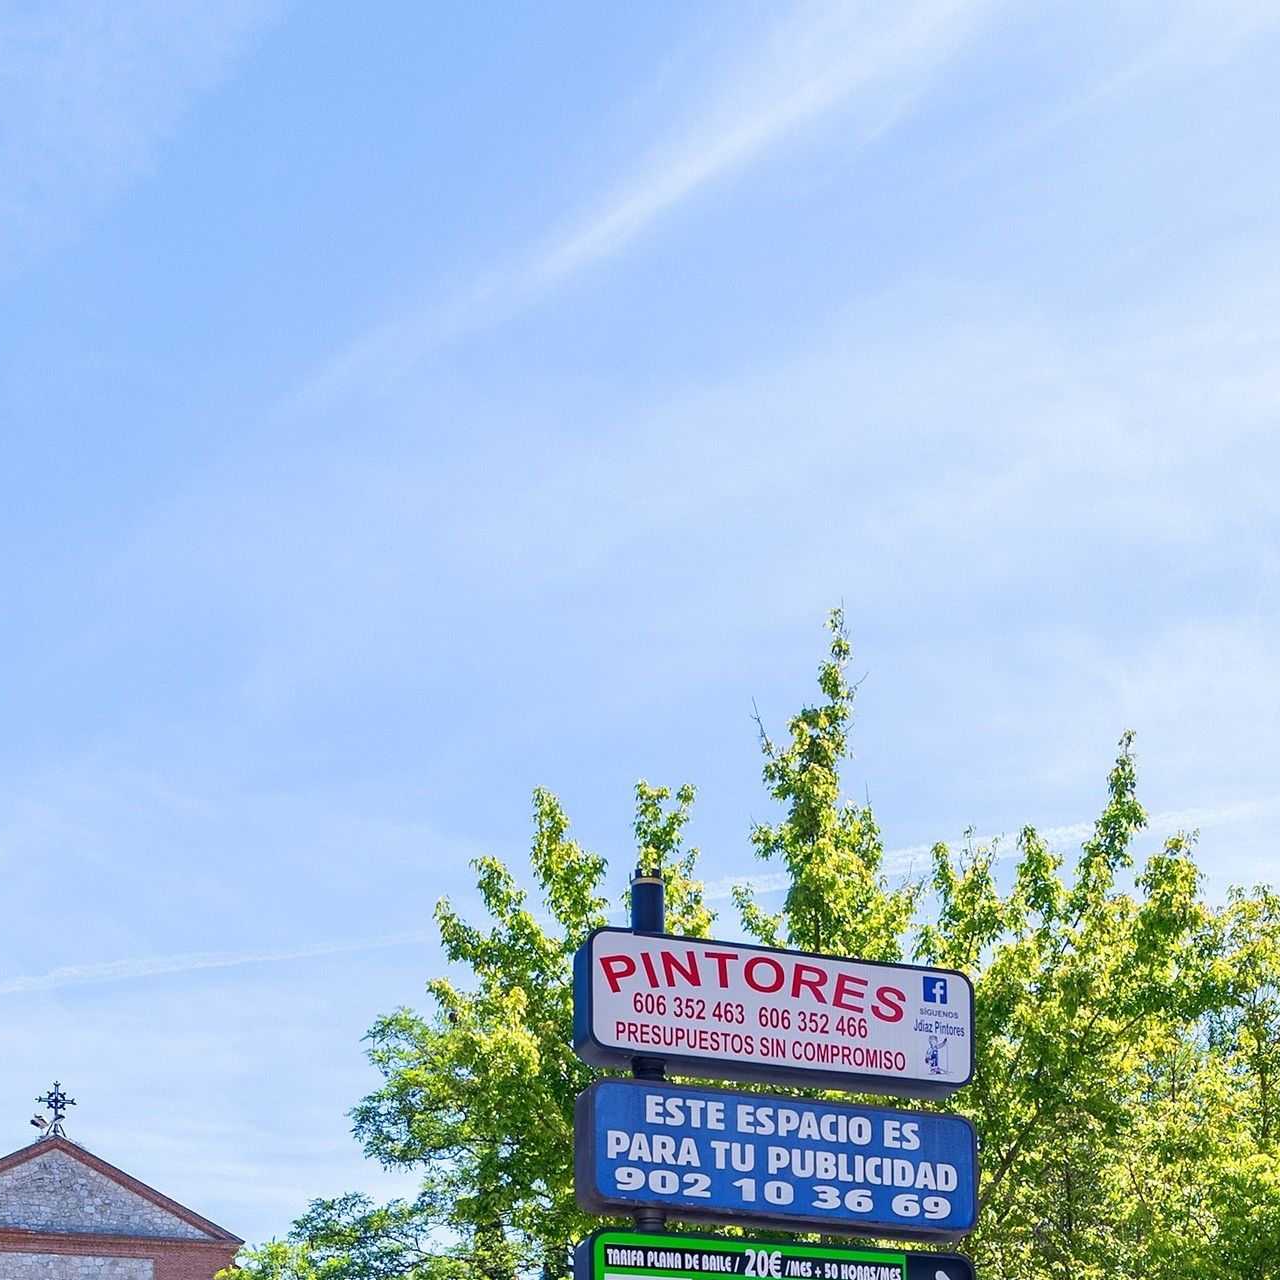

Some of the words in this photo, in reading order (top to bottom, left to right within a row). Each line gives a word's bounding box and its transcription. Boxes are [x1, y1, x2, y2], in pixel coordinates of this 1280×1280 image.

[599, 951, 907, 1023] PINTORES
[633, 992, 667, 1016] 606
[673, 996, 706, 1020] 352
[712, 1001, 745, 1025] 463
[758, 1006, 791, 1030] 606
[797, 1010, 829, 1034] 352
[835, 1015, 868, 1039] 466
[934, 1021, 965, 1037] Pintores
[615, 1021, 754, 1055] PRESUPUESTOS
[760, 1036, 786, 1058] SIN
[792, 1040, 906, 1071] COMPROMISO
[645, 1094, 725, 1131] ESTE
[736, 1104, 872, 1145] ESPACIO
[883, 1120, 920, 1151] ES
[606, 1130, 701, 1167] PARA
[710, 1140, 755, 1172] TU
[767, 1146, 958, 1192] PUBLICIDAD
[614, 1166, 712, 1198] 902
[732, 1178, 794, 1205] 10
[811, 1185, 874, 1213] 36
[891, 1193, 951, 1220] 69
[607, 1248, 645, 1266] TARIFA
[647, 1250, 682, 1269] PLANA
[684, 1253, 699, 1270] DE
[701, 1254, 731, 1272] BAILE
[744, 1248, 782, 1279] 20€
[824, 1263, 838, 1279] 50
